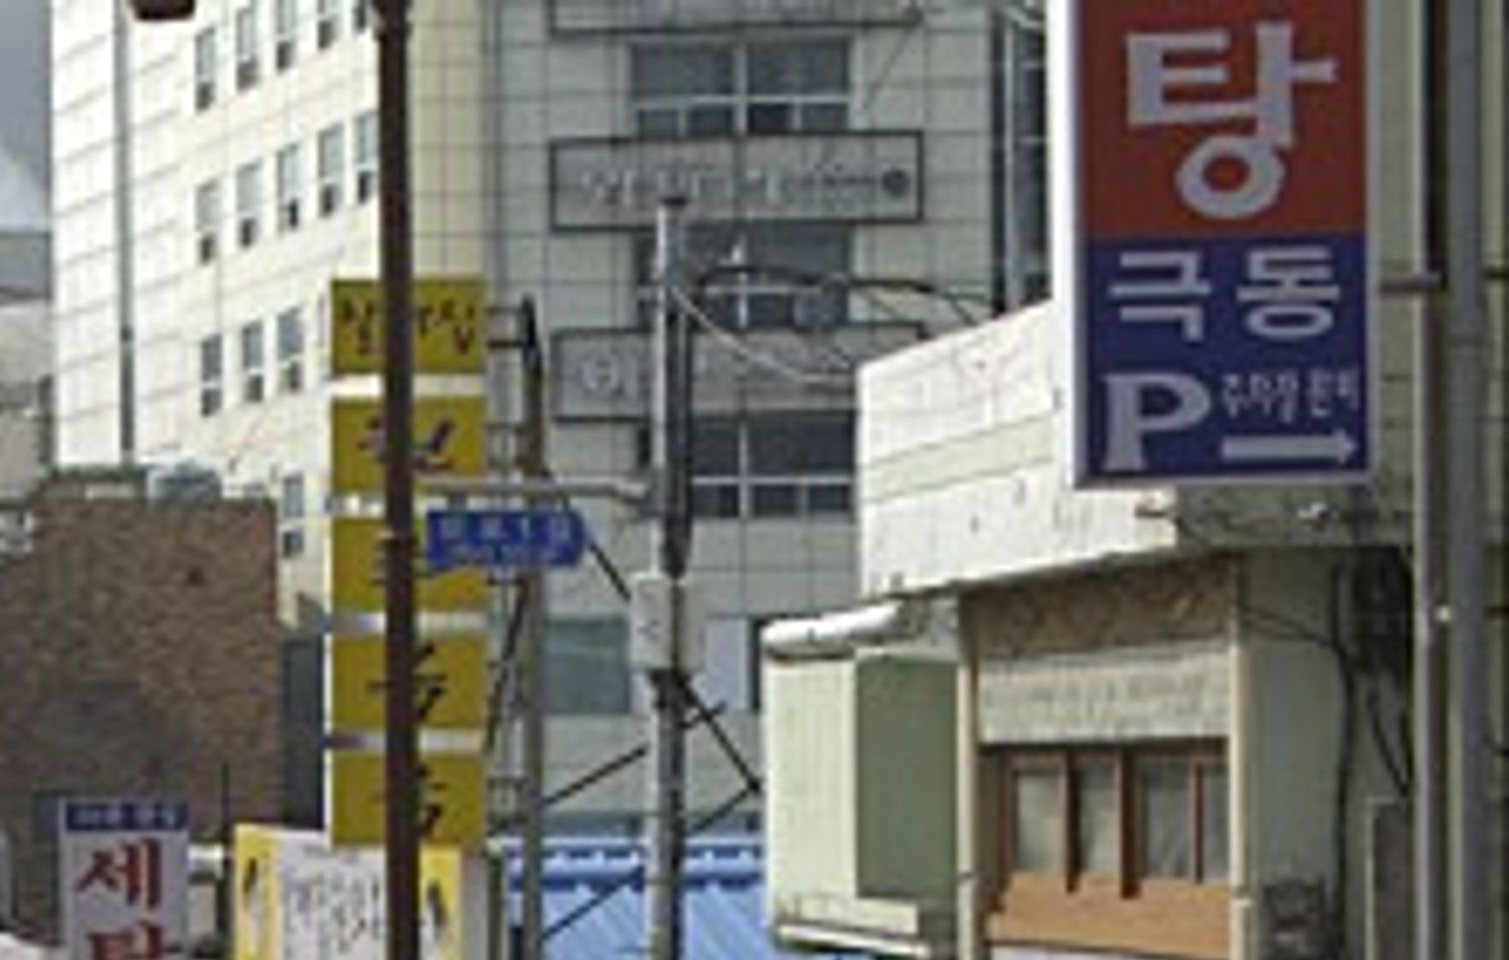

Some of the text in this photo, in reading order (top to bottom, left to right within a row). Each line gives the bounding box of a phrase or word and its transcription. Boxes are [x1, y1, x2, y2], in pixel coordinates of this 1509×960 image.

[1125, 20, 1338, 219] 탕
[1110, 246, 1340, 341] 극동
[1100, 373, 1211, 471] P
